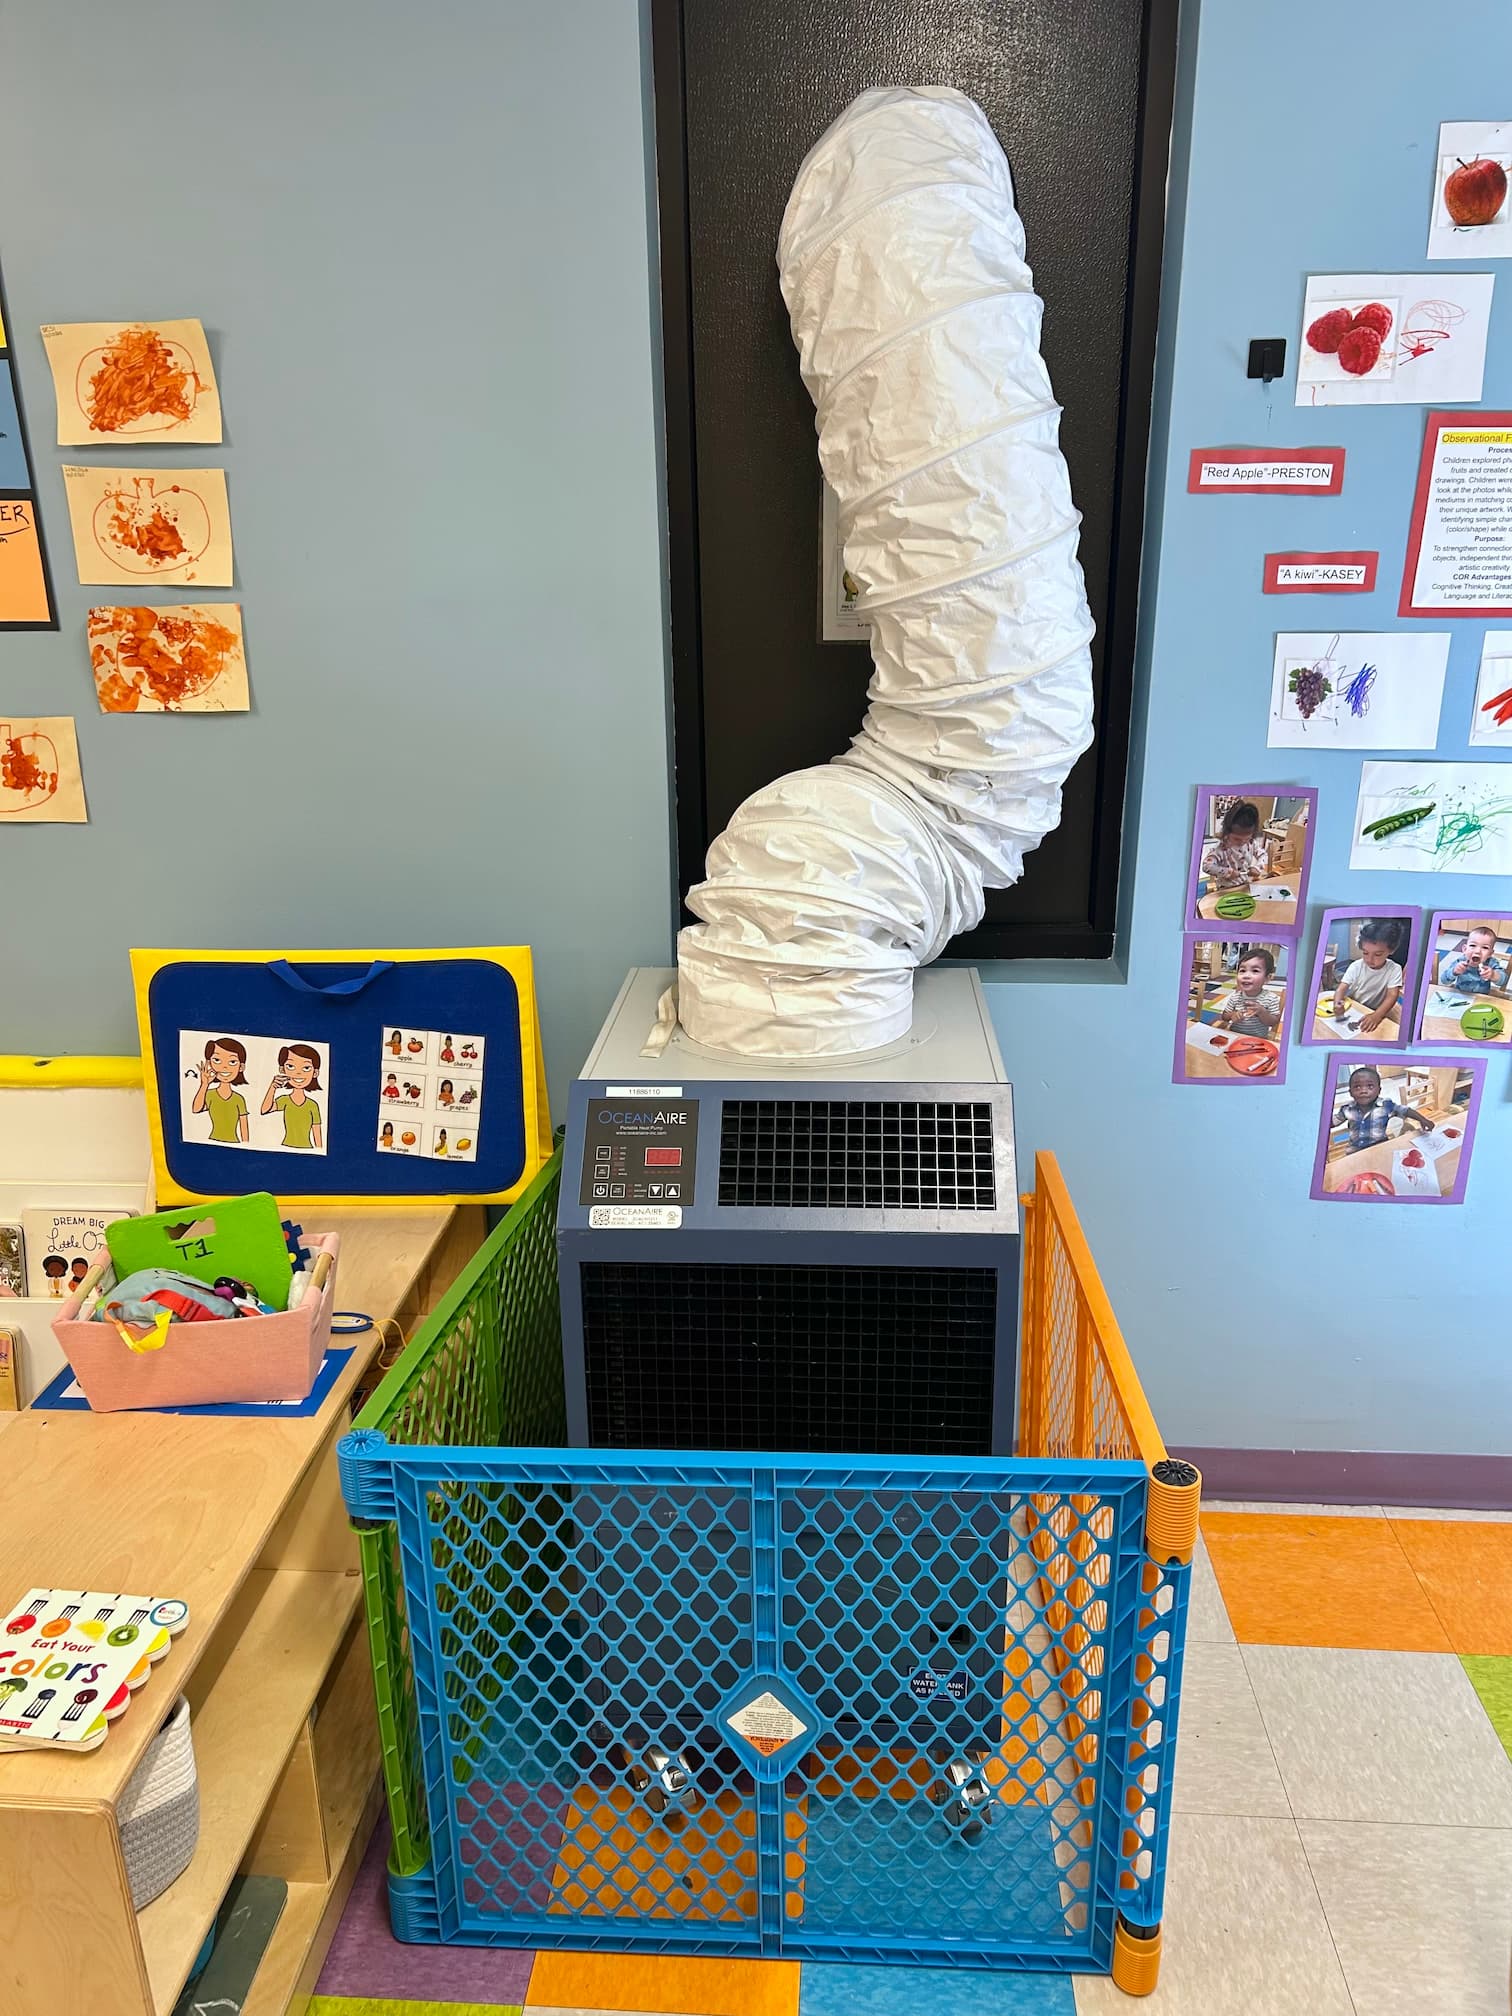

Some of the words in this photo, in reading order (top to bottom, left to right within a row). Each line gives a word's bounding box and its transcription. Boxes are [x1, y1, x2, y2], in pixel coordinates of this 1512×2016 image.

[1442, 433, 1504, 443] Observational
[1472, 457, 1501, 465] explored
[1431, 583, 1462, 591] Cognitive
[388, 1099, 420, 1107] strawberry
[53, 1216, 86, 1226] DREAM
[89, 1218, 105, 1229] BIG
[46, 1227, 82, 1252] Little
[175, 1238, 214, 1261] T1
[31, 1638, 58, 1649] Eat
[61, 1641, 95, 1653] Your
